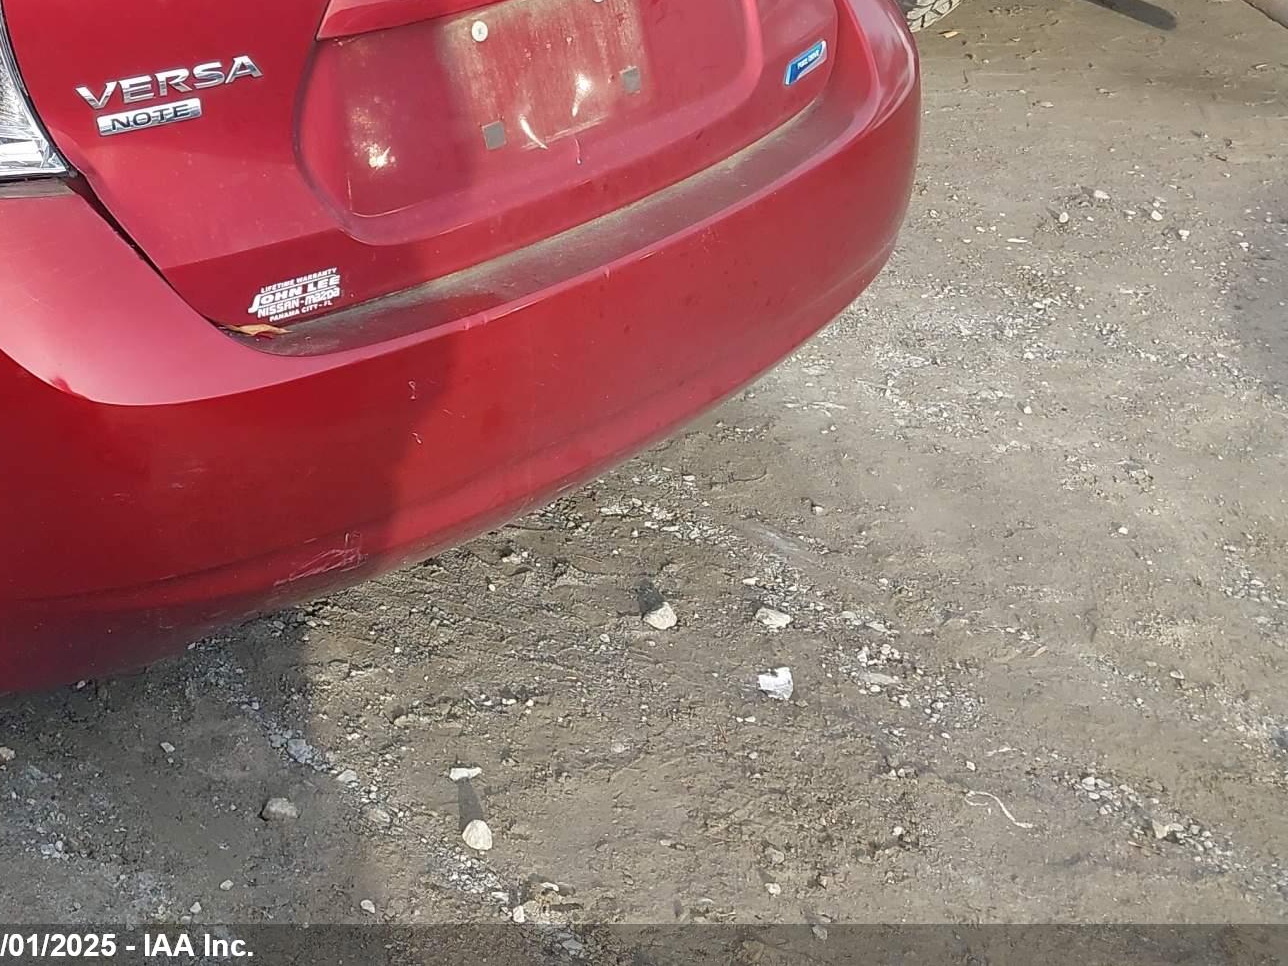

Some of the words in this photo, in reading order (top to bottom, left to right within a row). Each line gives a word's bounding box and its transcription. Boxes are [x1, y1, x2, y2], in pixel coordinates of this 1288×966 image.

[75, 55, 264, 110] VERSA
[111, 104, 191, 132] NOTE
[261, 279, 295, 293] LIFETIME
[296, 267, 338, 284] WARRANTY
[248, 286, 303, 314] JOHN
[307, 275, 341, 293] LEE
[257, 298, 300, 319] NISSAN
[269, 309, 300, 322] PANAMA
